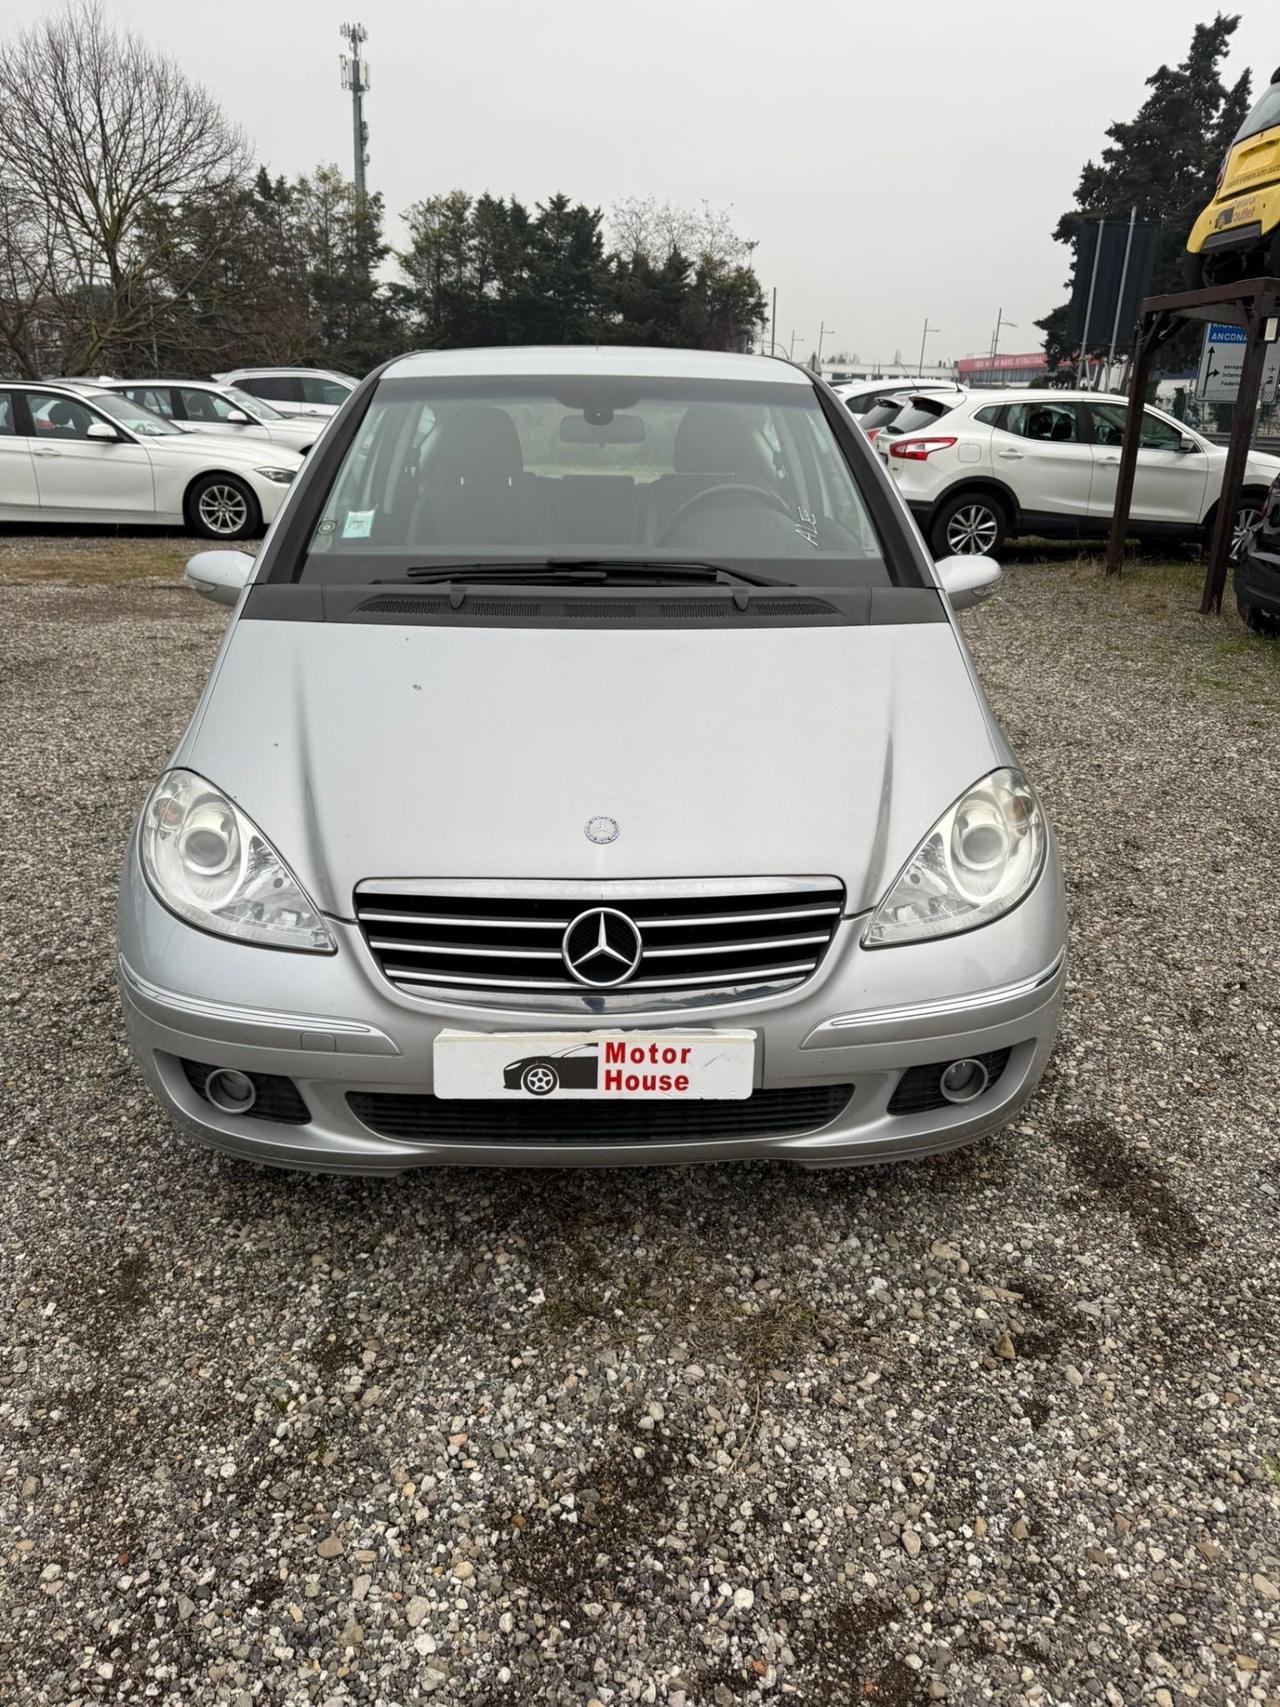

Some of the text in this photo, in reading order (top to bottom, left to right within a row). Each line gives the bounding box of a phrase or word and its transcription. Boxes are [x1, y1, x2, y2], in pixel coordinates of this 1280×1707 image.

[794, 506, 818, 546] ALE
[605, 1042, 692, 1064] Motor
[605, 1069, 690, 1092] House
